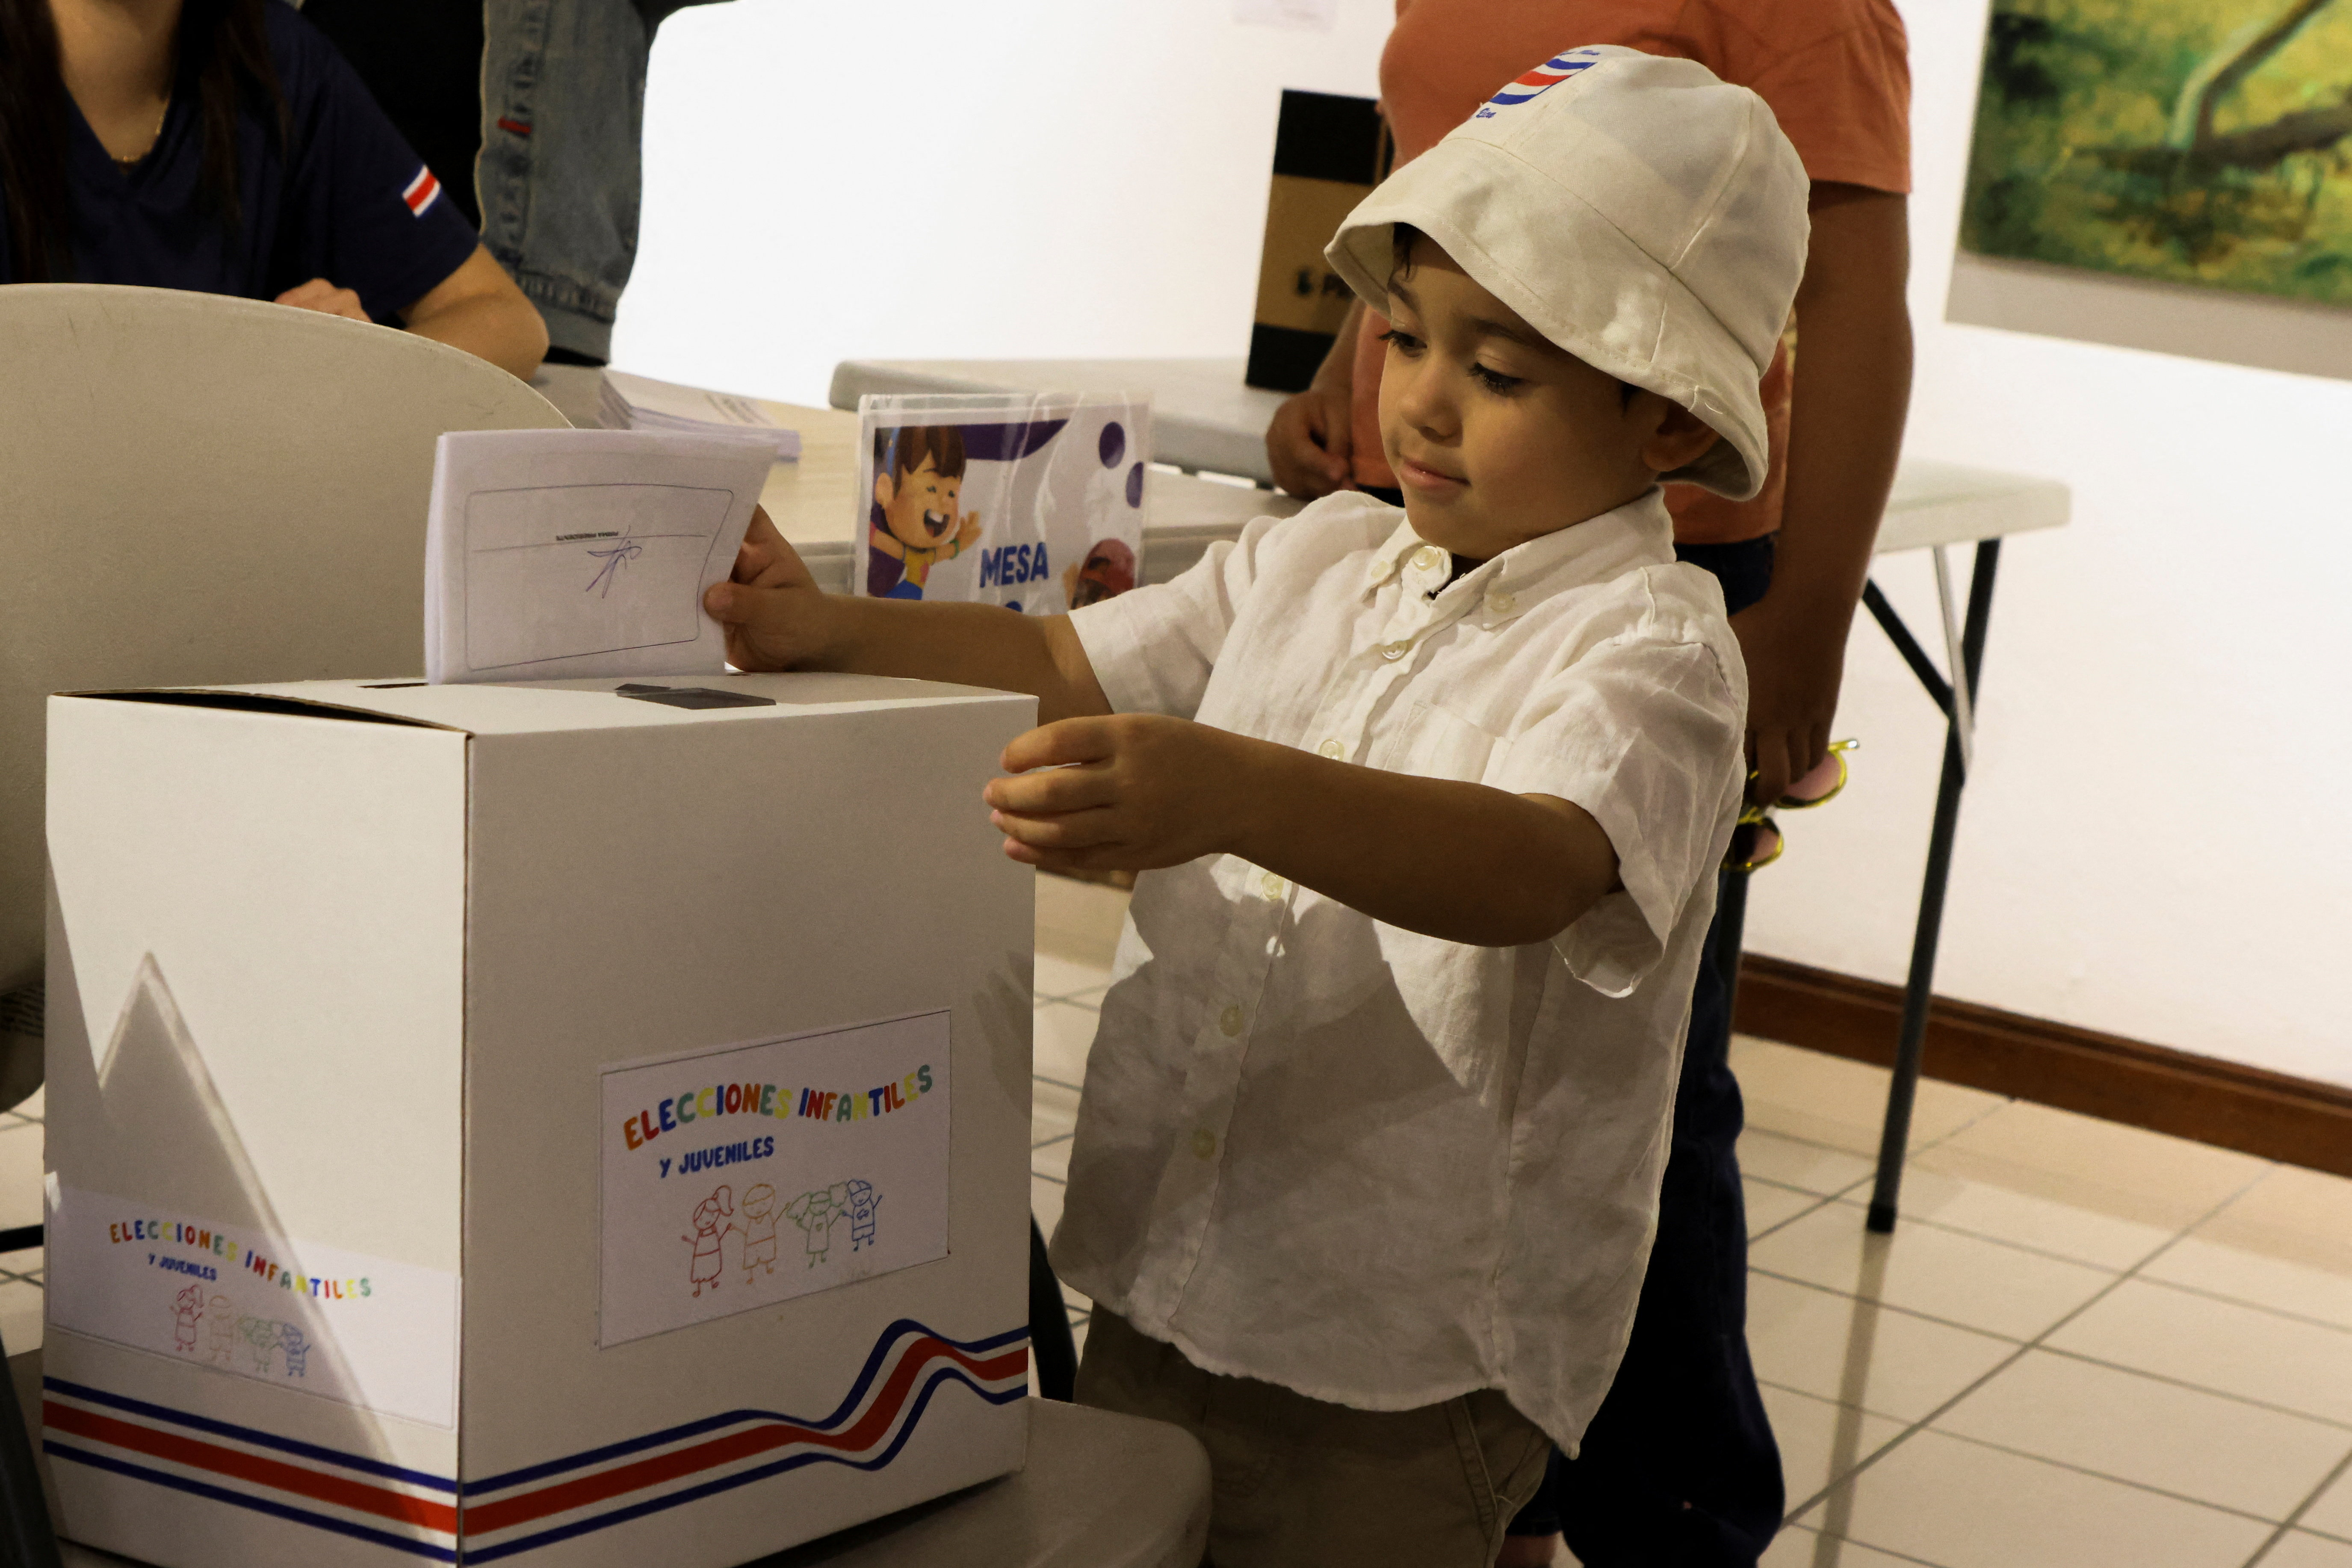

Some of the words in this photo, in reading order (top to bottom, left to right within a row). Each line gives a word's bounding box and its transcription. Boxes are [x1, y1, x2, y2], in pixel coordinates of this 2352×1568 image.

[980, 542, 1049, 588] MESA
[623, 1084, 792, 1150] ELECCIONES
[798, 1064, 932, 1122] INFANTILES
[659, 1158, 671, 1178] Y
[679, 1136, 774, 1174] JUVENILES
[110, 1220, 237, 1261] ELECCIONES
[245, 1250, 371, 1299] INFANTILES
[149, 1253, 156, 1265] Y
[160, 1256, 217, 1281] JUVENILES
